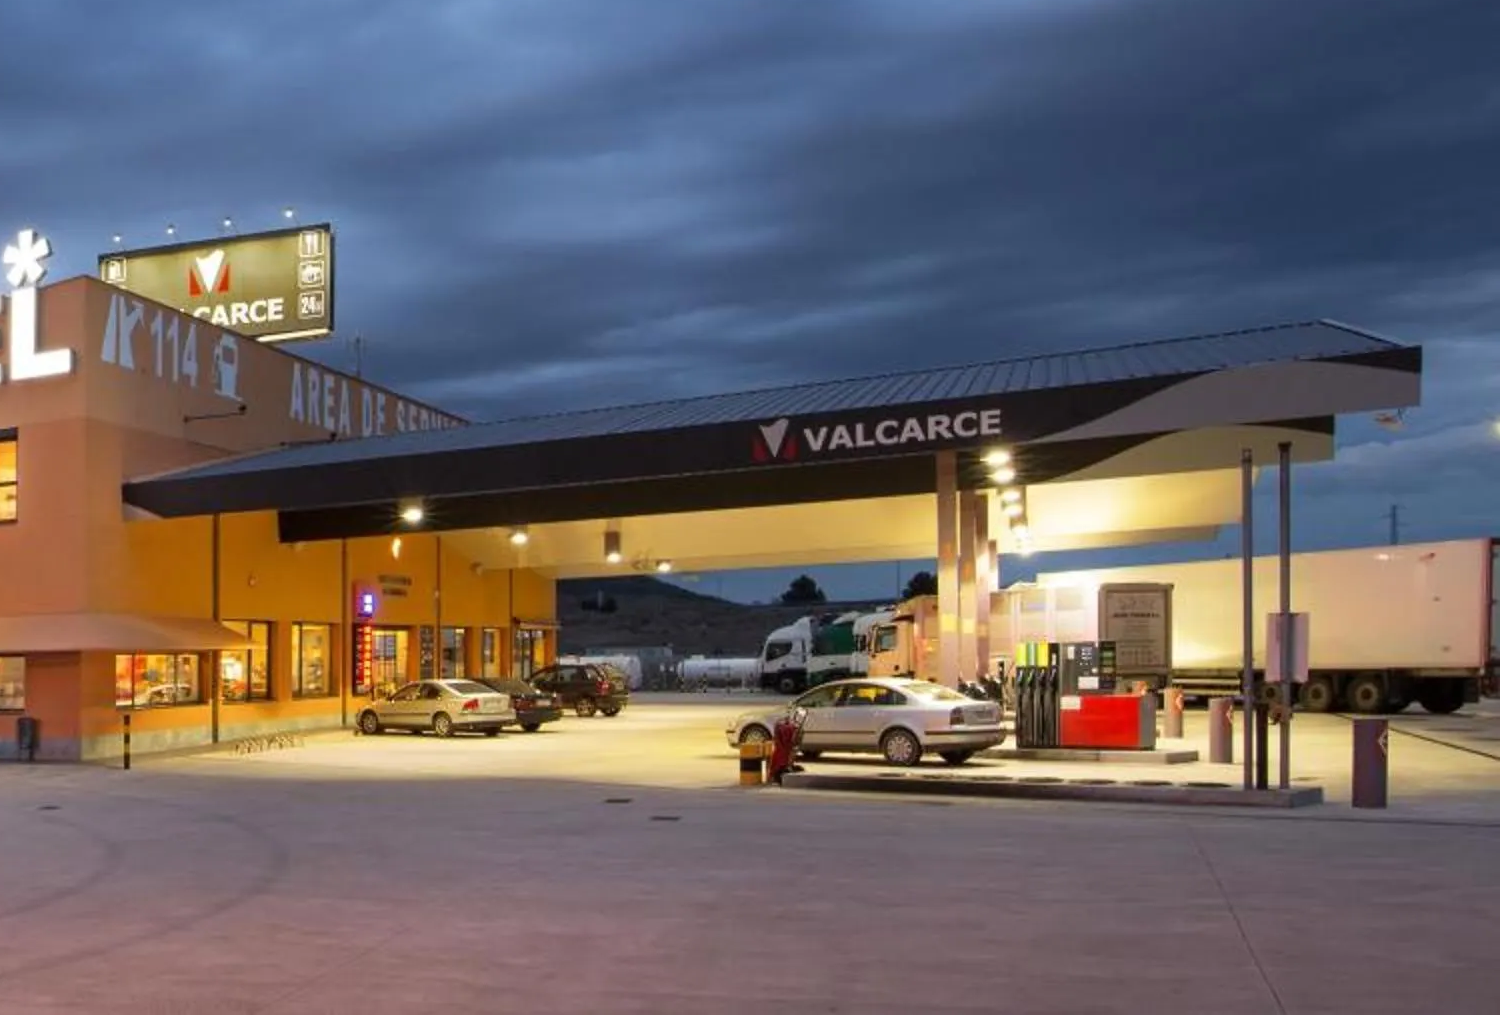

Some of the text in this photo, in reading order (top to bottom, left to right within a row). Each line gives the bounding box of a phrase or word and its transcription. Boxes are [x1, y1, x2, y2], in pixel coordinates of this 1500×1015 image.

[151, 309, 198, 387] 114
[289, 361, 351, 435] AREA
[362, 386, 386, 437] DE
[803, 409, 1002, 452] VALCARCE
